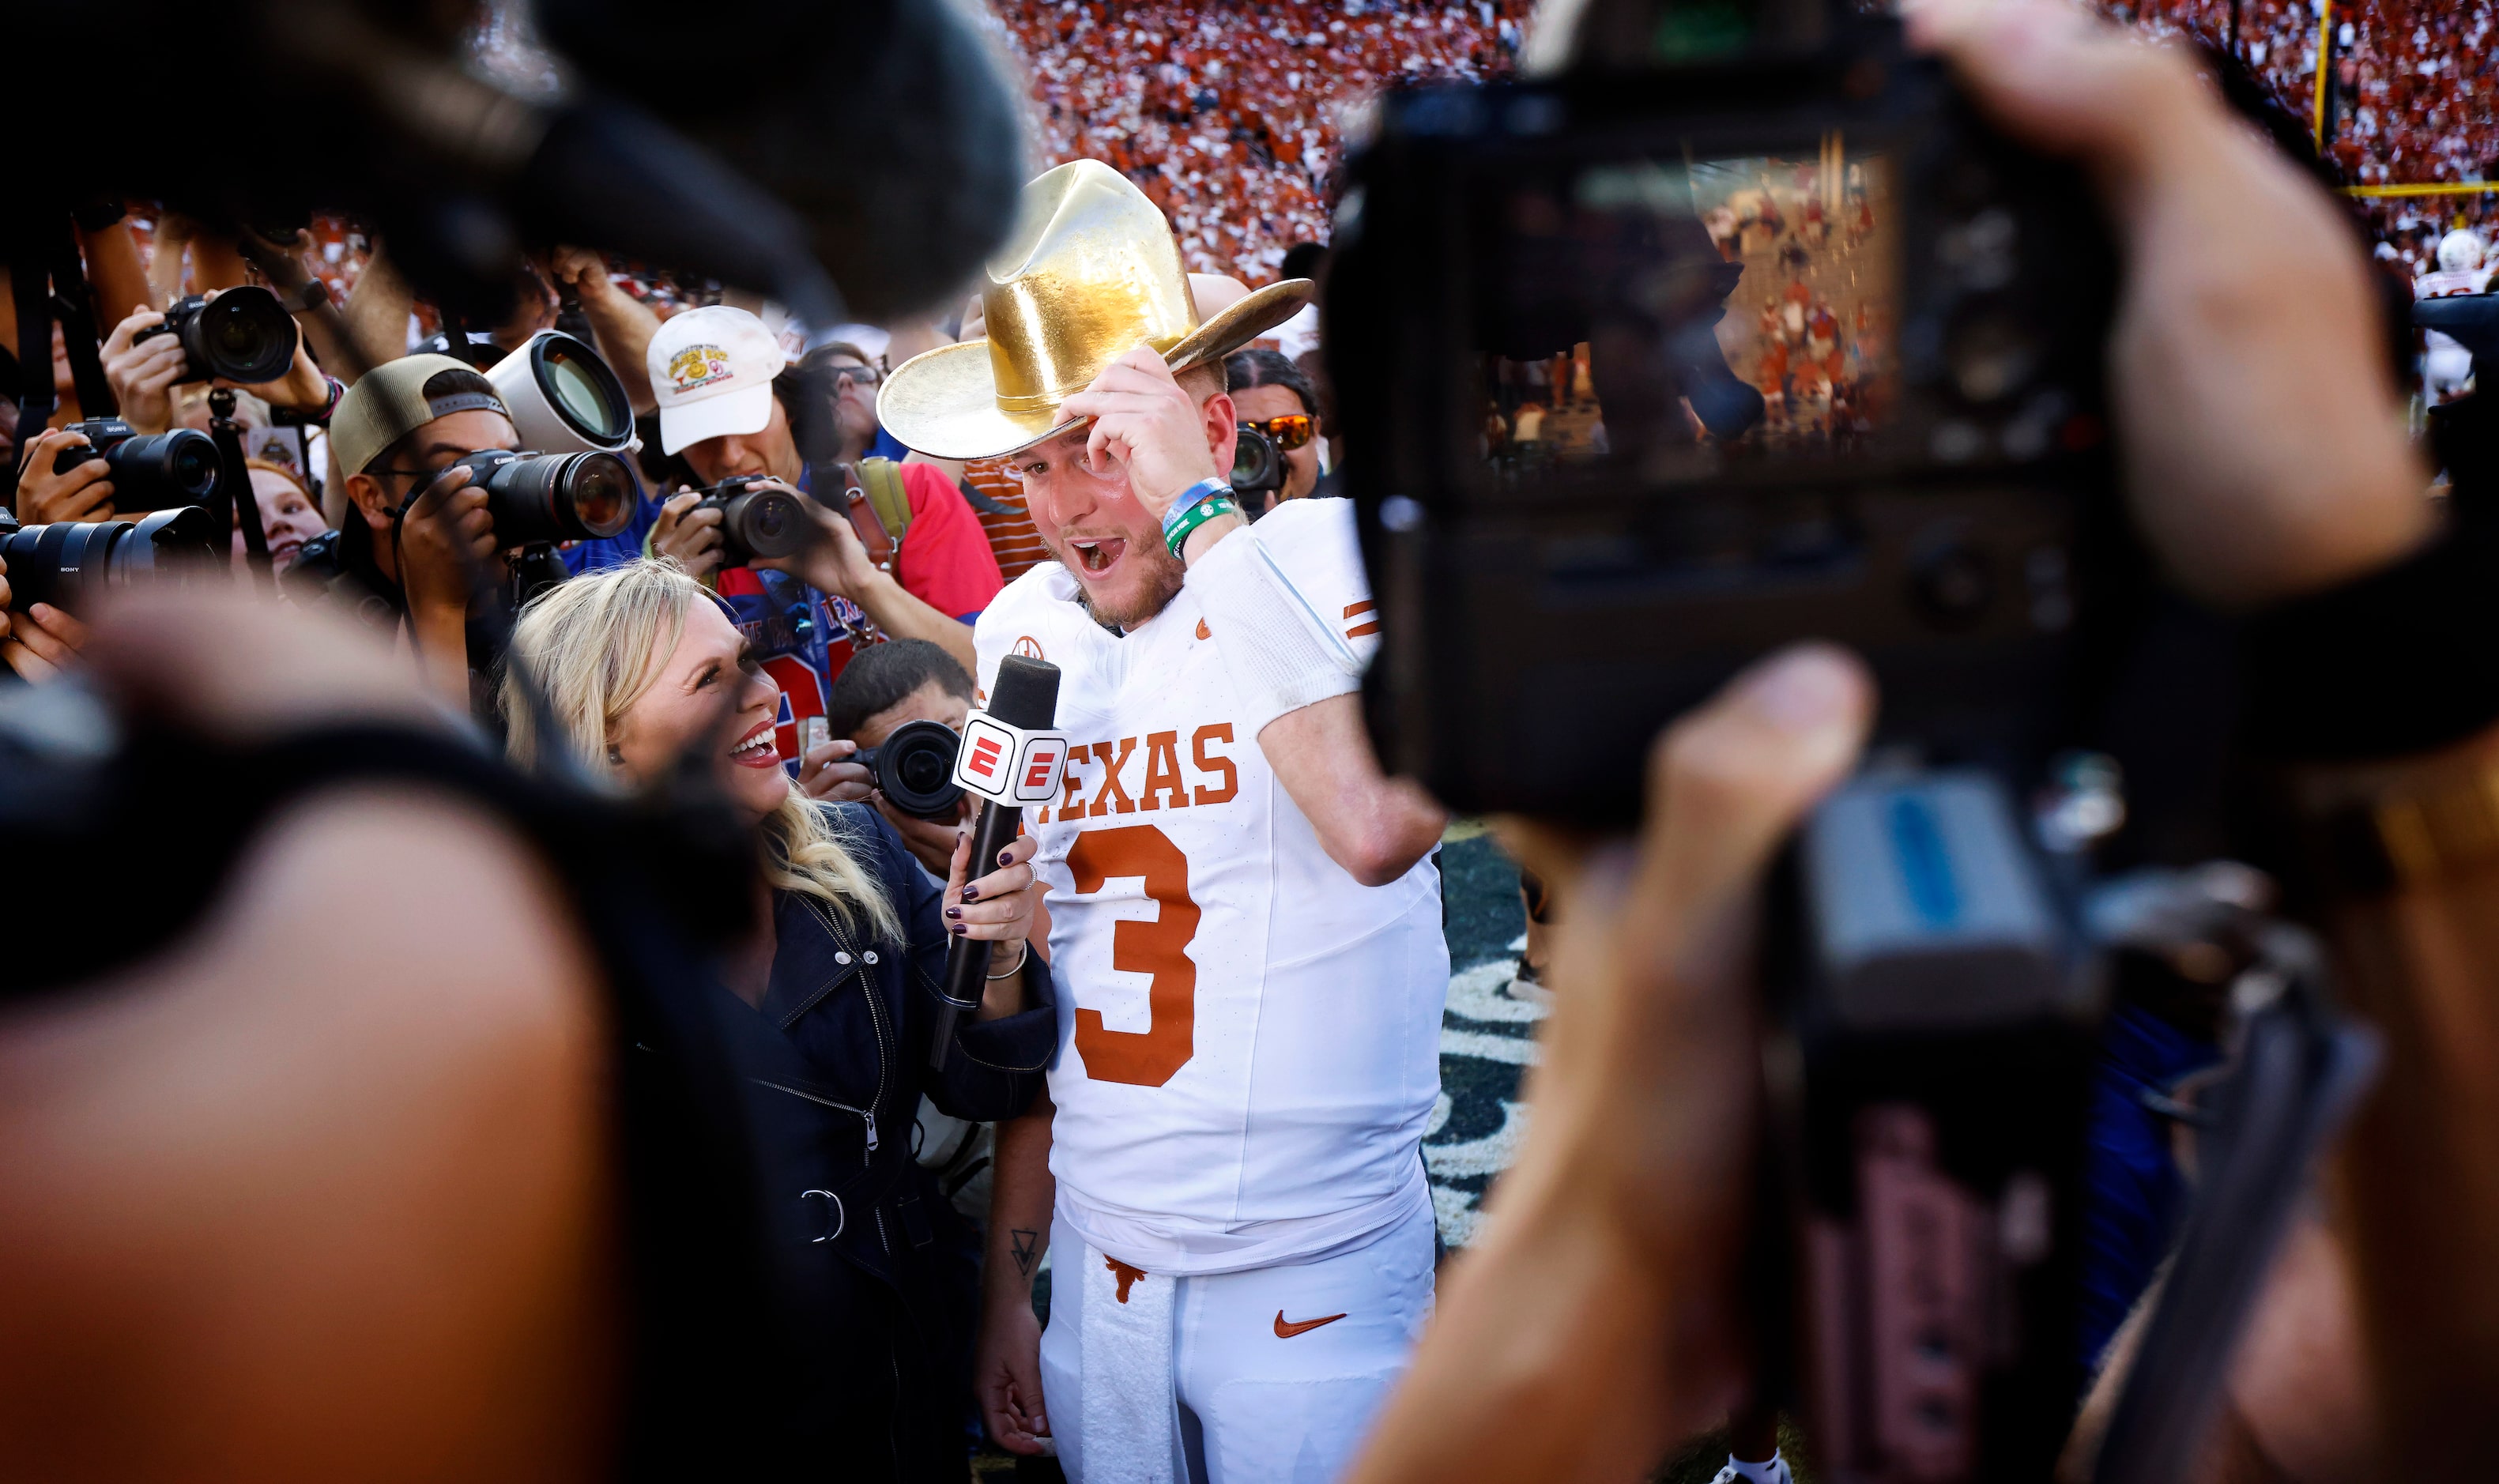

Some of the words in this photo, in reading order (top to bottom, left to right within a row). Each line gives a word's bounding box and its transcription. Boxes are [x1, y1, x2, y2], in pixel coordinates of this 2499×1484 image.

[494, 457, 516, 465] Canon
[968, 736, 1002, 778] E
[1024, 752, 1055, 787] E
[1038, 722, 1238, 824] EXAS
[1066, 823, 1201, 1087] 3
